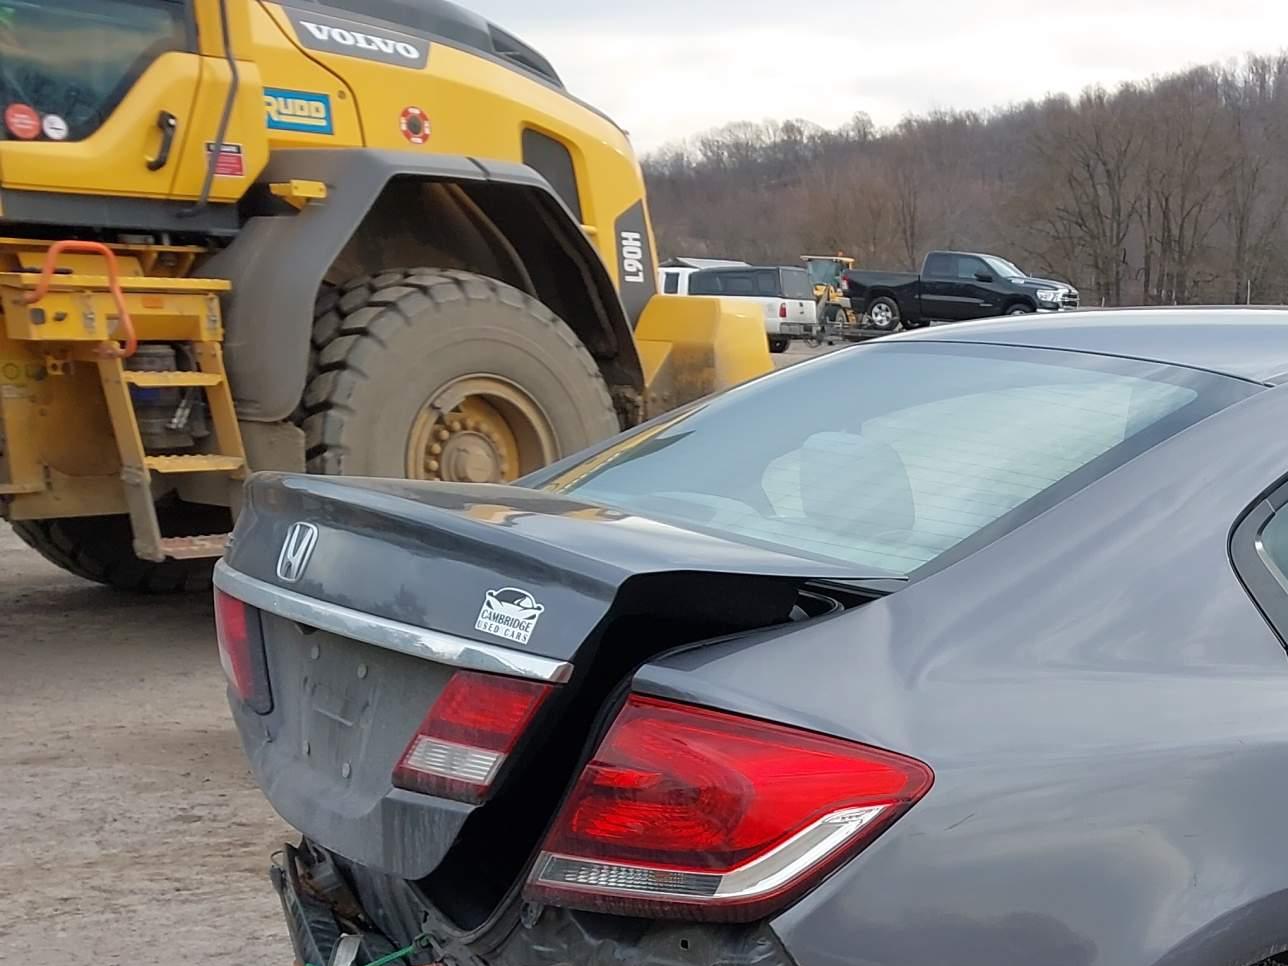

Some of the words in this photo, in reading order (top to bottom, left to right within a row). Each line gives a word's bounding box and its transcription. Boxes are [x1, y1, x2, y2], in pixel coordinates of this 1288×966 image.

[299, 20, 420, 59] VOLVO
[620, 231, 645, 283] L90H
[477, 619, 500, 634] USED
[503, 628, 529, 642] CARS
[481, 608, 532, 633] CAMBRIDGE
